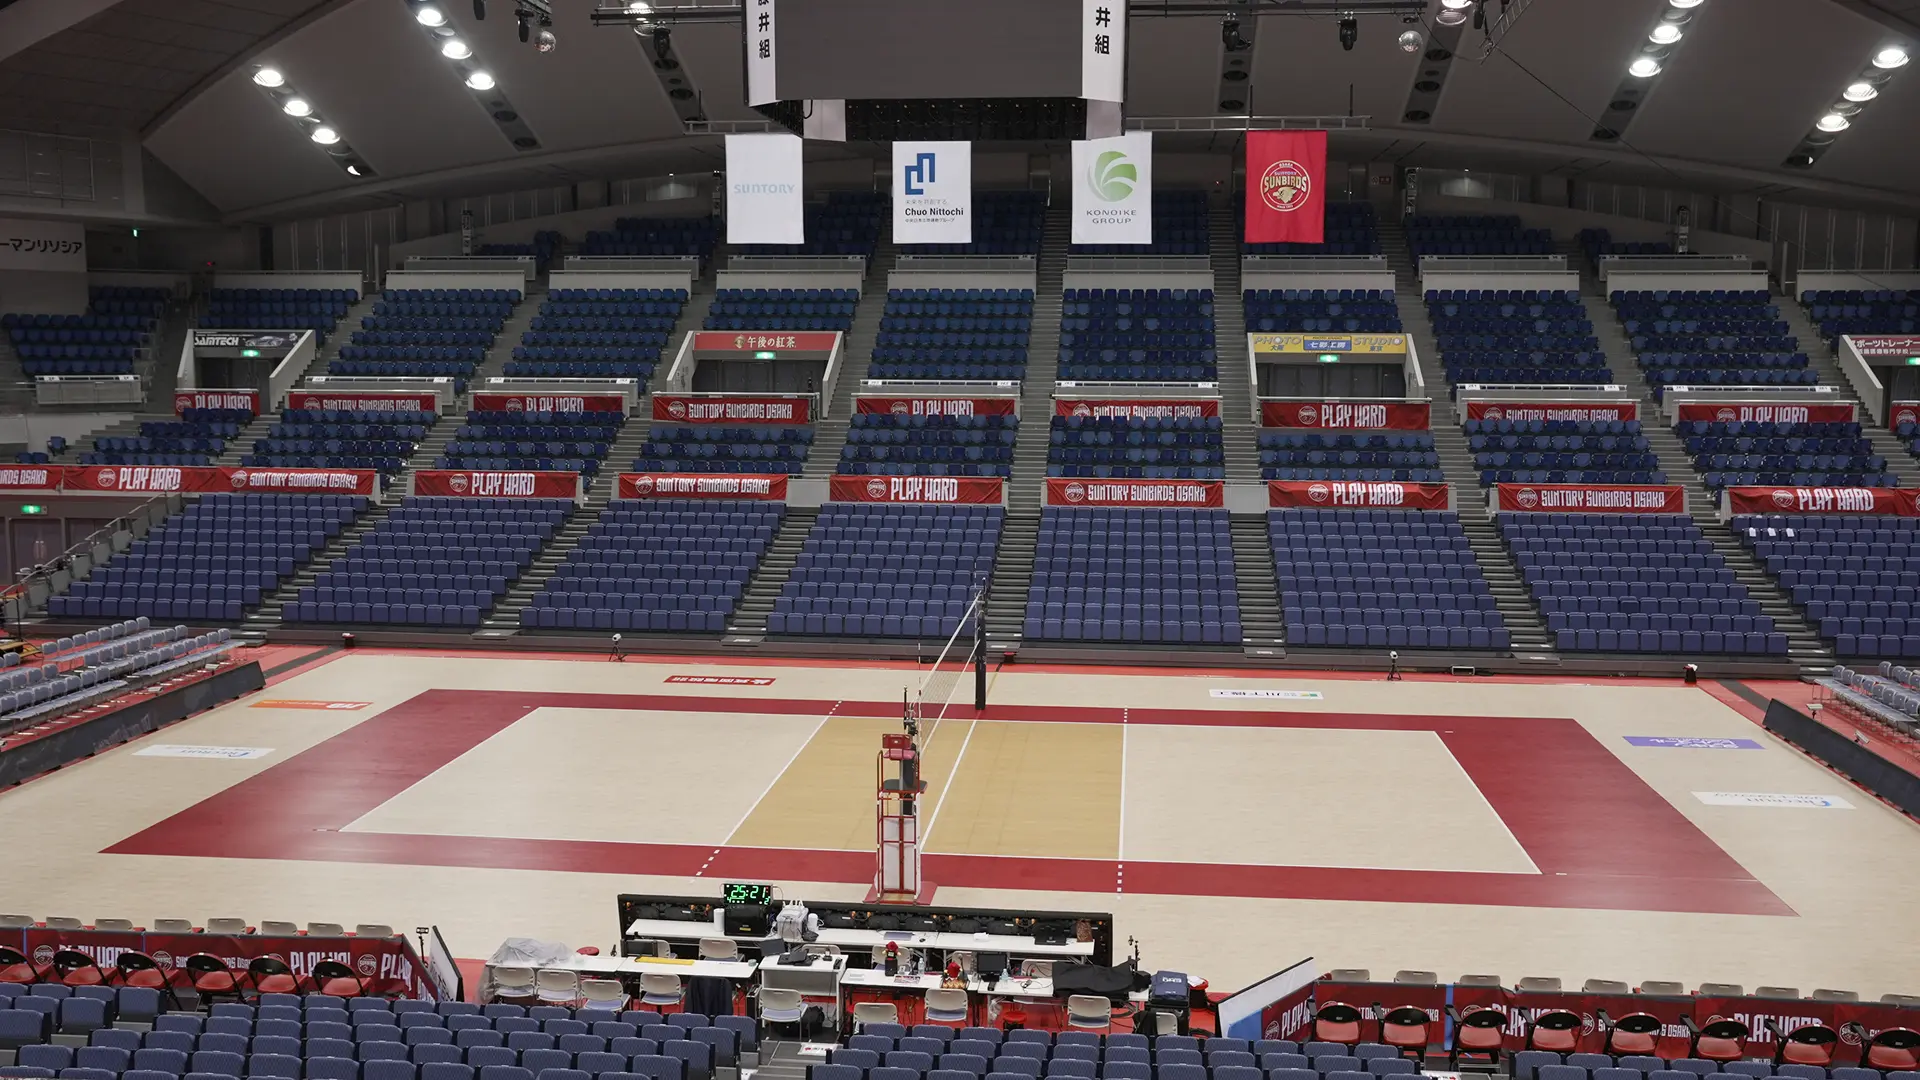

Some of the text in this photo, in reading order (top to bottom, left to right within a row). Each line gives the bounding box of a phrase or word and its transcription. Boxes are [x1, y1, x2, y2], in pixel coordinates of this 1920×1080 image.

[1095, 6, 1111, 55] 井組
[734, 184, 795, 194] SUNTORY
[1263, 175, 1307, 193] SUNBIRDS
[905, 207, 964, 216] Chuo Nittochi
[194, 336, 239, 346] SAMTECH
[747, 336, 796, 348] 午後の紅茶
[1254, 335, 1301, 345] PHOTO
[1354, 336, 1403, 345] STUDIO
[689, 404, 792, 418] SUNTORY SUNBIRDS OSAKA
[1321, 405, 1386, 427] PLAY HARD
[0, 469, 47, 484] IRDS OSAKA
[119, 468, 182, 490] PLAY HARD
[250, 472, 358, 490] SUNTORY SUNBIRDS OSAKA
[471, 473, 535, 495] PLAY HARD
[656, 477, 771, 494] SUNTORY SUNBIRDS OSAKA
[890, 477, 958, 501] PLAY HARD
[1088, 484, 1206, 502] SUNTORY SUNBIRDS OSAKA
[1332, 482, 1404, 505] PLAY HARD
[1541, 489, 1665, 508] SUNTORY SUNBIRDS OSAKA
[1797, 488, 1875, 511] PLAY HARD
